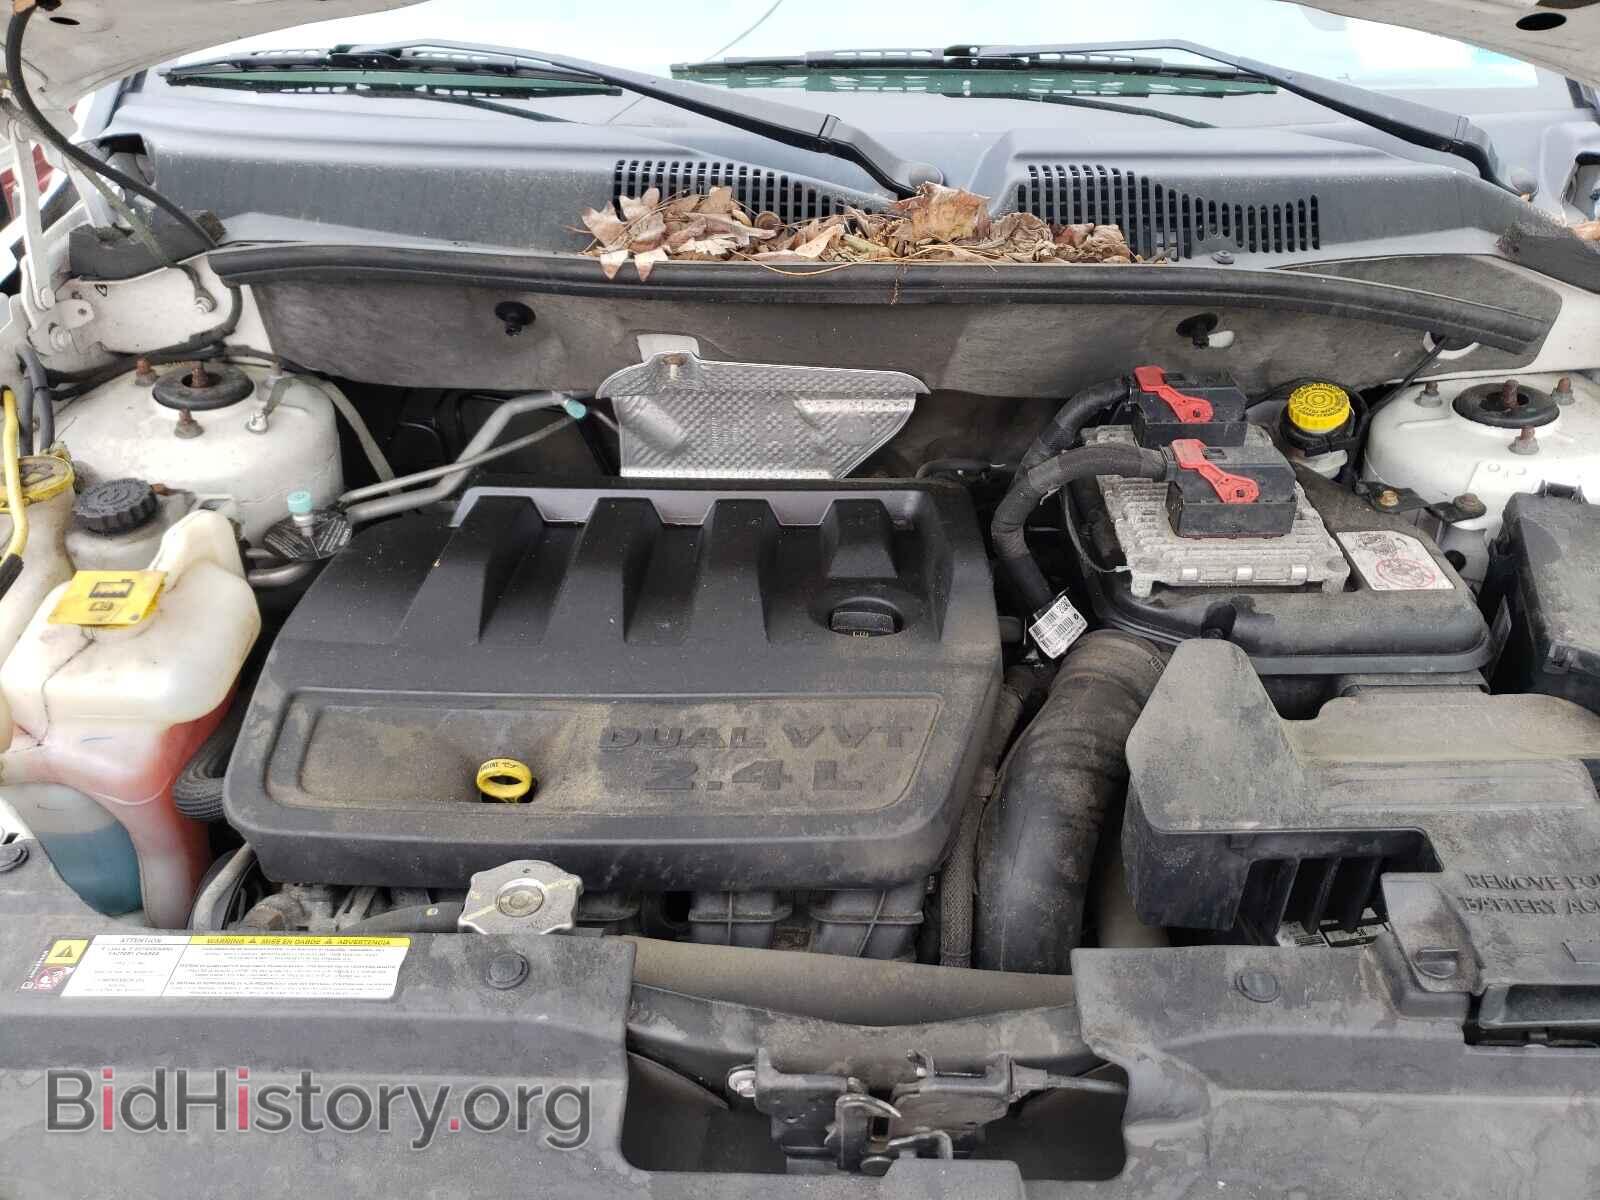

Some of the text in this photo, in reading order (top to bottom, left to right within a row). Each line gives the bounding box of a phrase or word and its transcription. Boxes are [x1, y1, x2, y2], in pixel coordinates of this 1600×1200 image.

[599, 725, 913, 749] DUAL VVT
[645, 759, 863, 791] 2.4L
[1464, 873, 1564, 891] REMOVE
[1459, 896, 1557, 914] BATTERY
